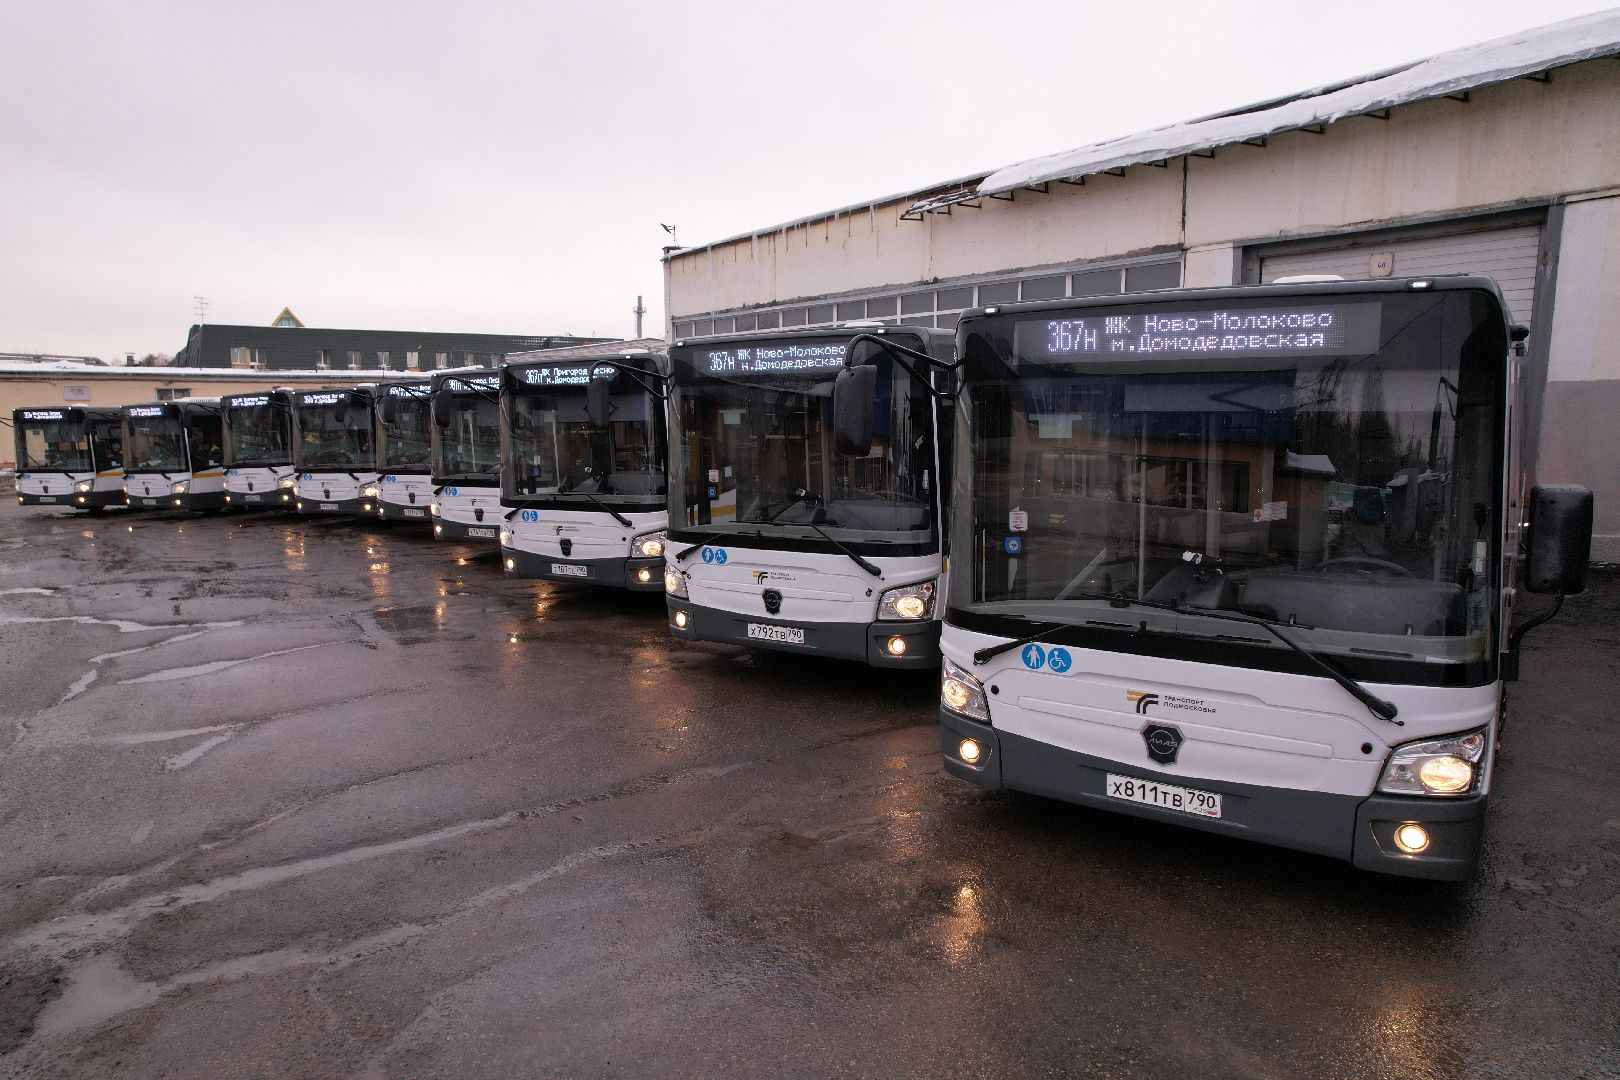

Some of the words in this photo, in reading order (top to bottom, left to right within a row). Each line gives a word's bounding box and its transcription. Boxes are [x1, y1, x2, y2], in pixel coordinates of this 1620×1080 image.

[1105, 315, 1131, 334] ЖК
[1144, 312, 1333, 333] Ново-Молоково
[1048, 320, 1096, 353] 367Н
[1112, 333, 1324, 353] м.Домодедовская
[709, 352, 734, 371] 367Н
[737, 349, 751, 360] ЖК
[757, 345, 846, 359] Ново-Молоково
[1163, 701, 1216, 713] ПОДМОСКОВЬЯ
[1164, 695, 1204, 706] ТРАНСПОРТ
[1113, 781, 1183, 808] Х811ТВ
[1187, 791, 1216, 809] 790
